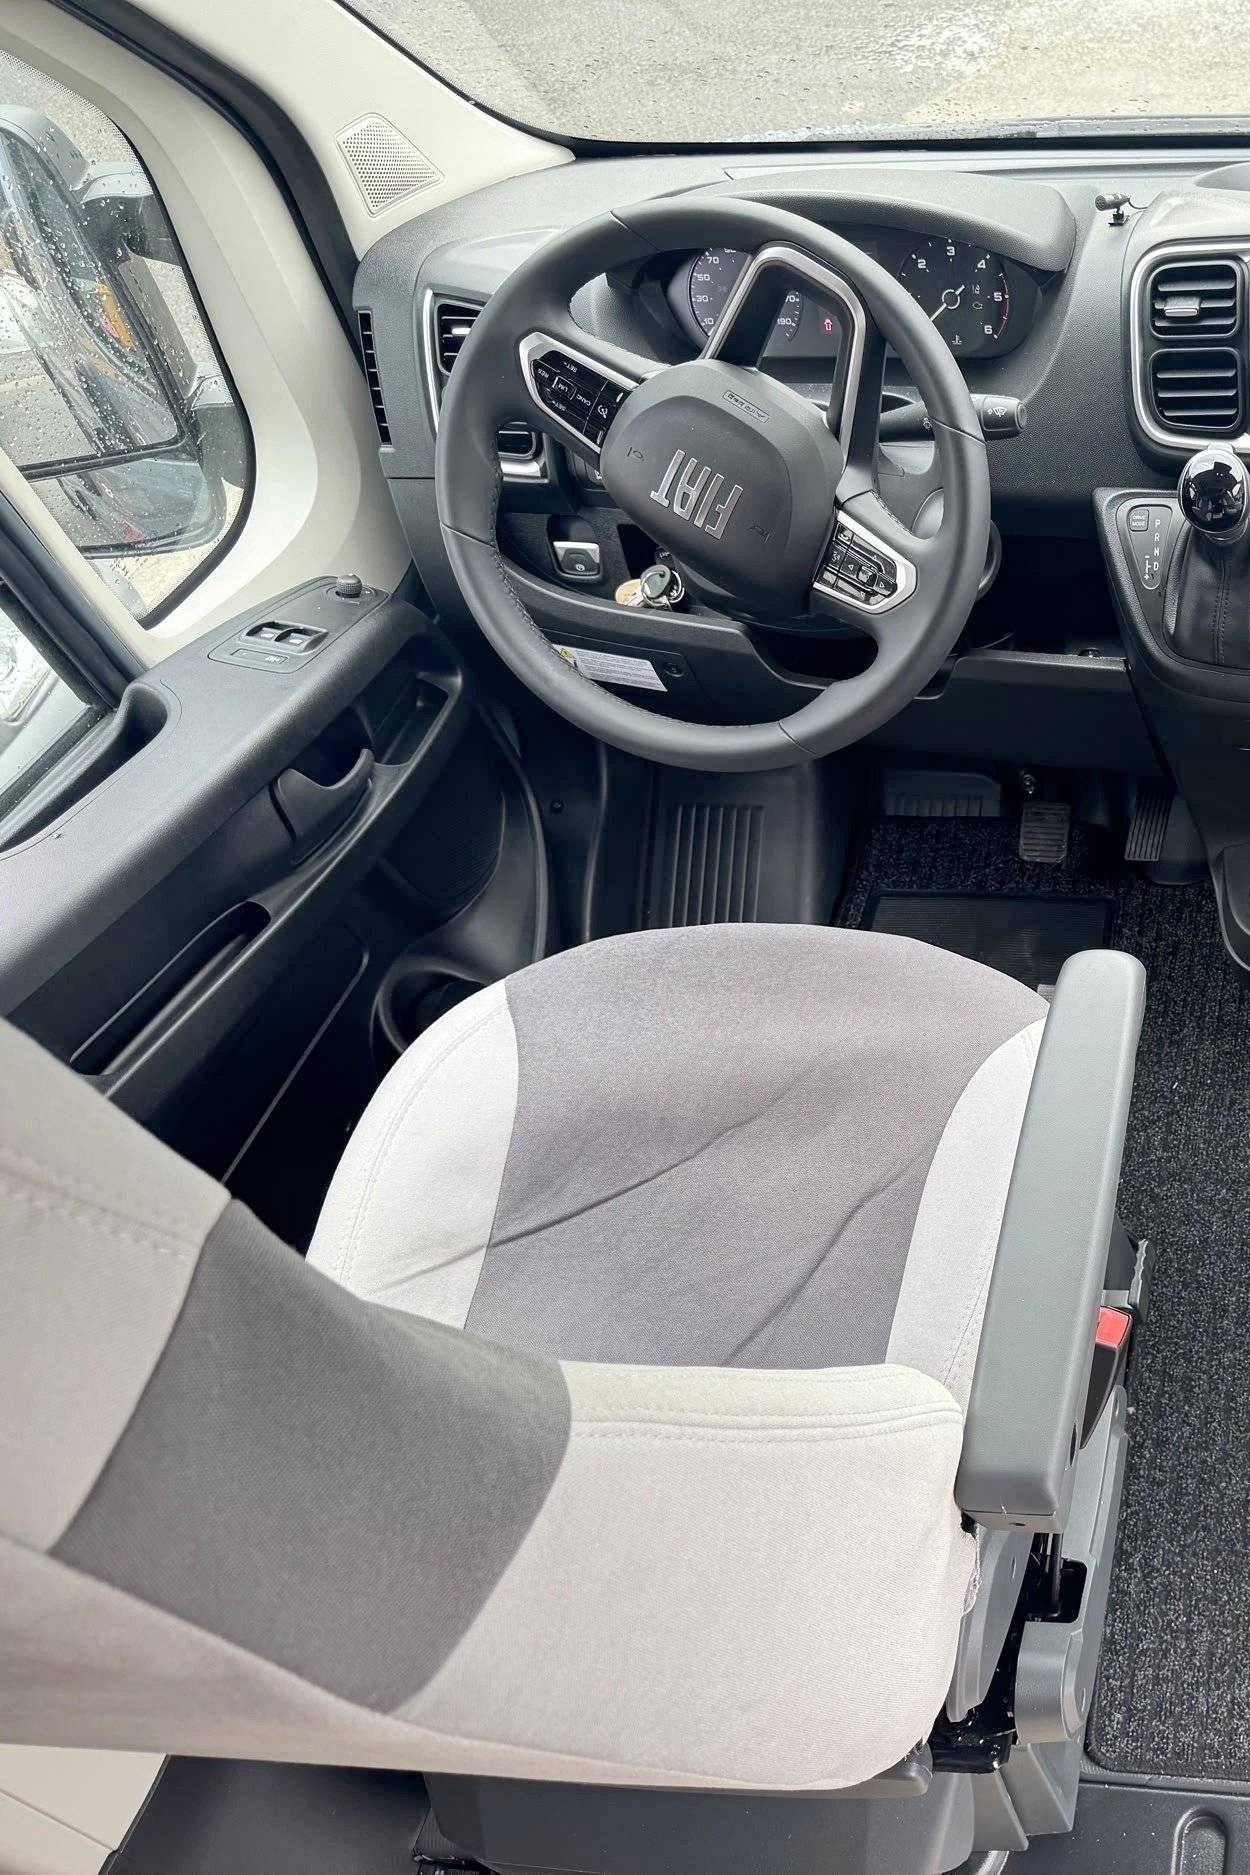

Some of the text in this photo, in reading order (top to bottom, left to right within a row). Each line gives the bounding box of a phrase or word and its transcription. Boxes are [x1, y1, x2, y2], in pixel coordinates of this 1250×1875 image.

[946, 246, 955, 256] 3
[917, 259, 926, 269] 2
[977, 260, 986, 269] 4
[993, 292, 1002, 301] 5
[984, 325, 993, 334] 6
[650, 449, 744, 540] FIAT
[1155, 519, 1161, 527] P
[1154, 533, 1160, 541] R
[1153, 547, 1159, 556] N
[1153, 562, 1159, 570] D
